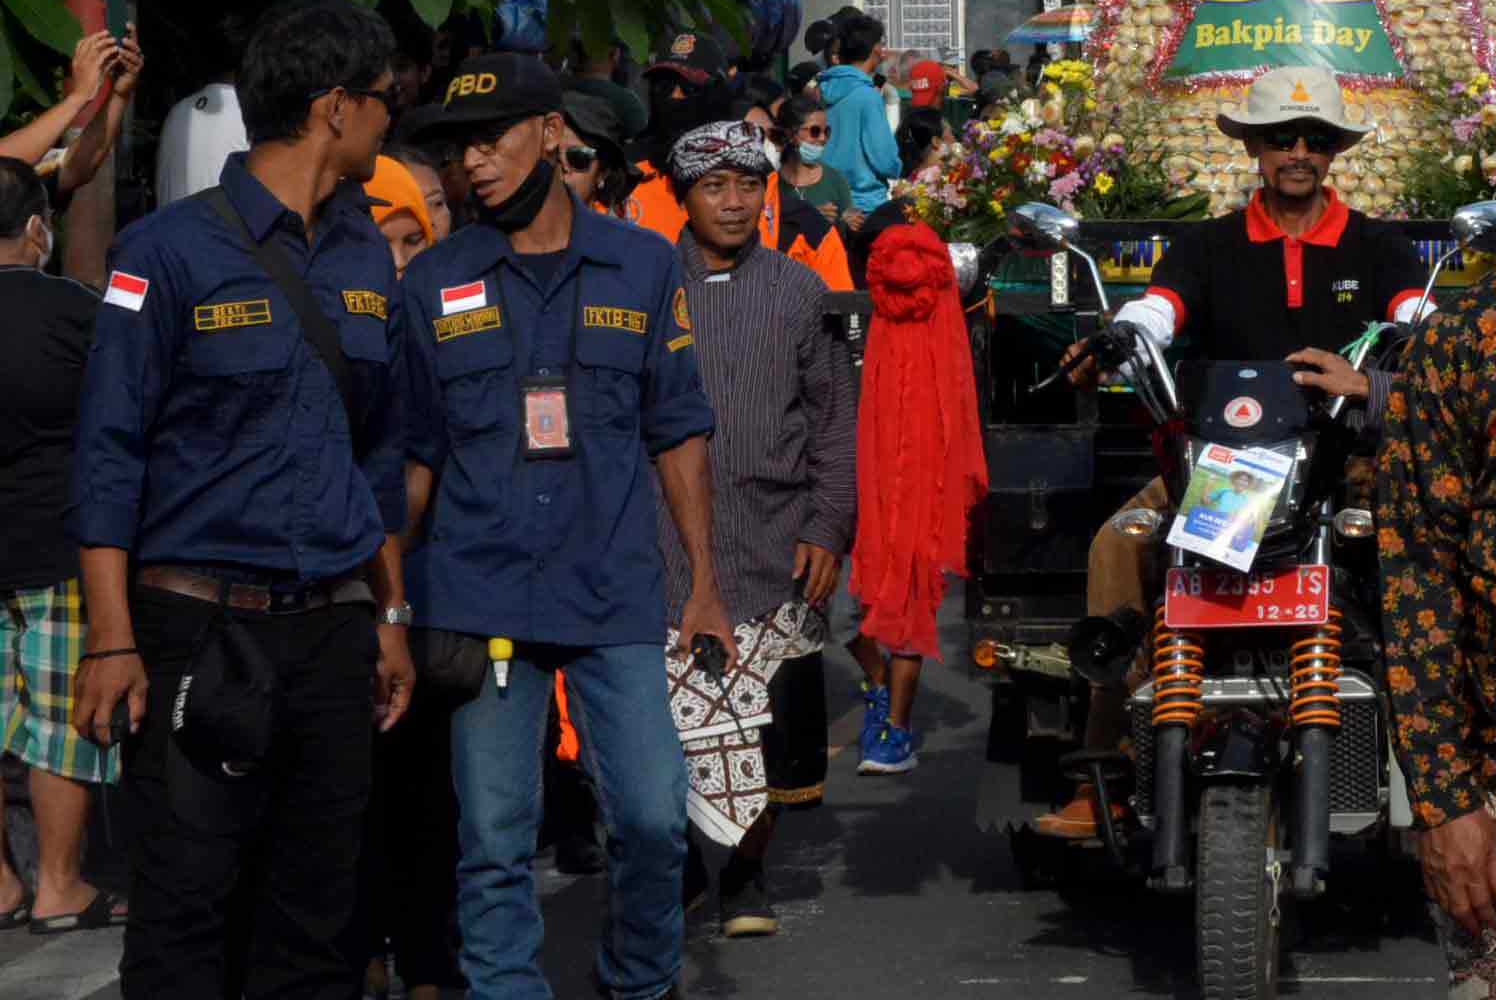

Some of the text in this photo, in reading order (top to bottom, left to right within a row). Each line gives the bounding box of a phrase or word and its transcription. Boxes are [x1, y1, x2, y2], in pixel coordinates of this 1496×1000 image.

[1195, 16, 1374, 53] Bakpia Day
[1170, 574, 1202, 598] AB
